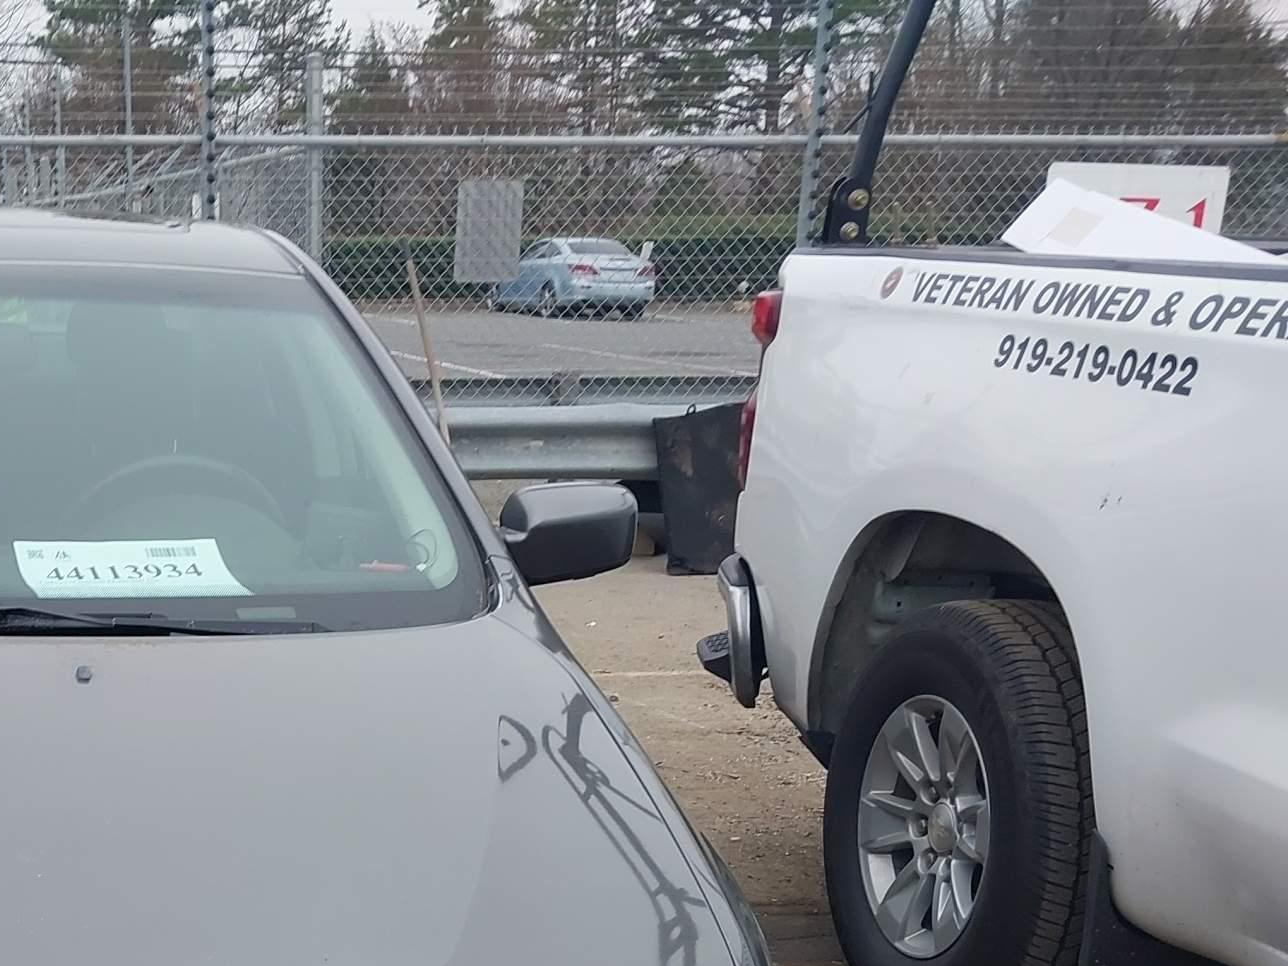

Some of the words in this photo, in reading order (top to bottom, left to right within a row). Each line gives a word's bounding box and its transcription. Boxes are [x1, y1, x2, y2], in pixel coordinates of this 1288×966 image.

[912, 271, 1036, 313] VETERAN
[1033, 280, 1150, 324] OWNED
[1150, 290, 1184, 327] &
[1189, 294, 1288, 342] OPER
[994, 334, 1199, 397] 919-219-0422
[46, 562, 203, 581] 44113934
